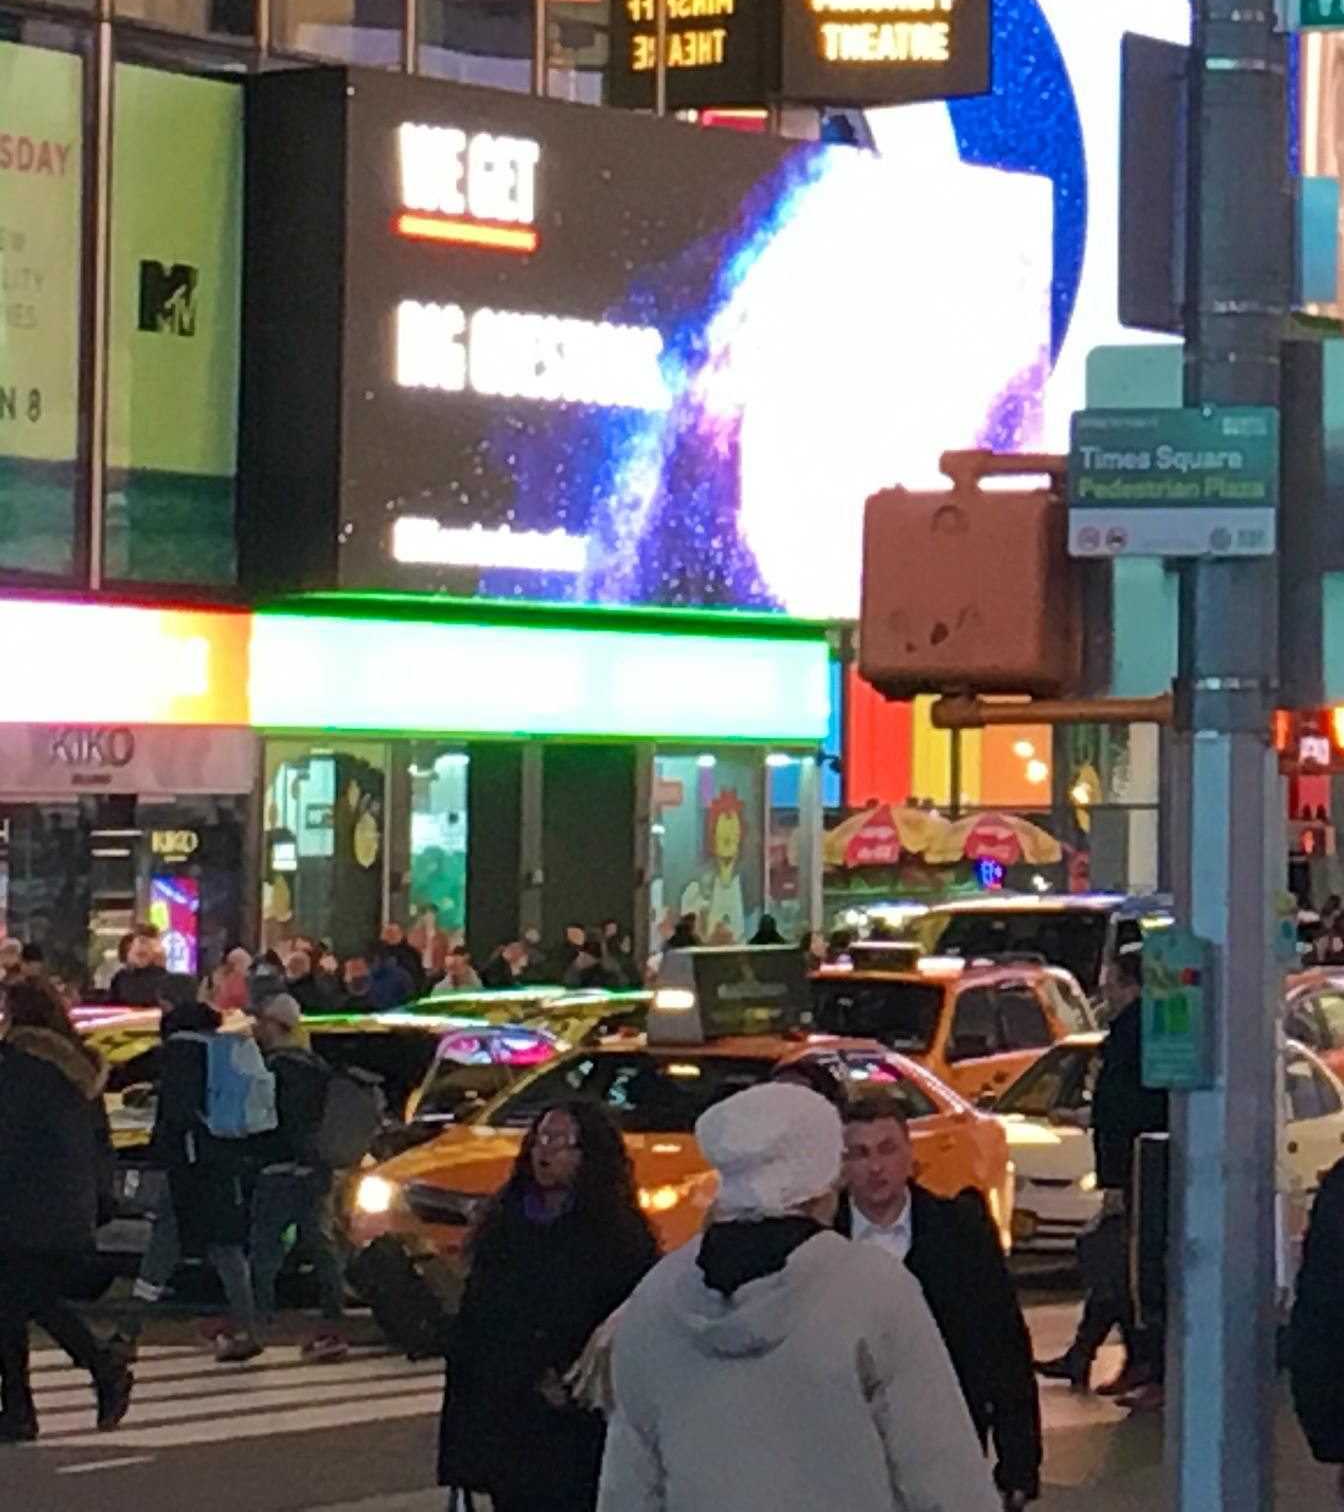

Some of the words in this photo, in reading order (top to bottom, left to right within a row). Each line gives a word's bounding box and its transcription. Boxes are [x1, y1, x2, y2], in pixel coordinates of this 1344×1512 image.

[138, 258, 198, 337] MTV
[27, 387, 42, 424] 8
[1079, 445, 1151, 470] Times
[1155, 444, 1243, 473] Square
[1078, 478, 1200, 499] Pedestrian
[1204, 477, 1265, 499] Plaza
[49, 727, 135, 767] KIKO
